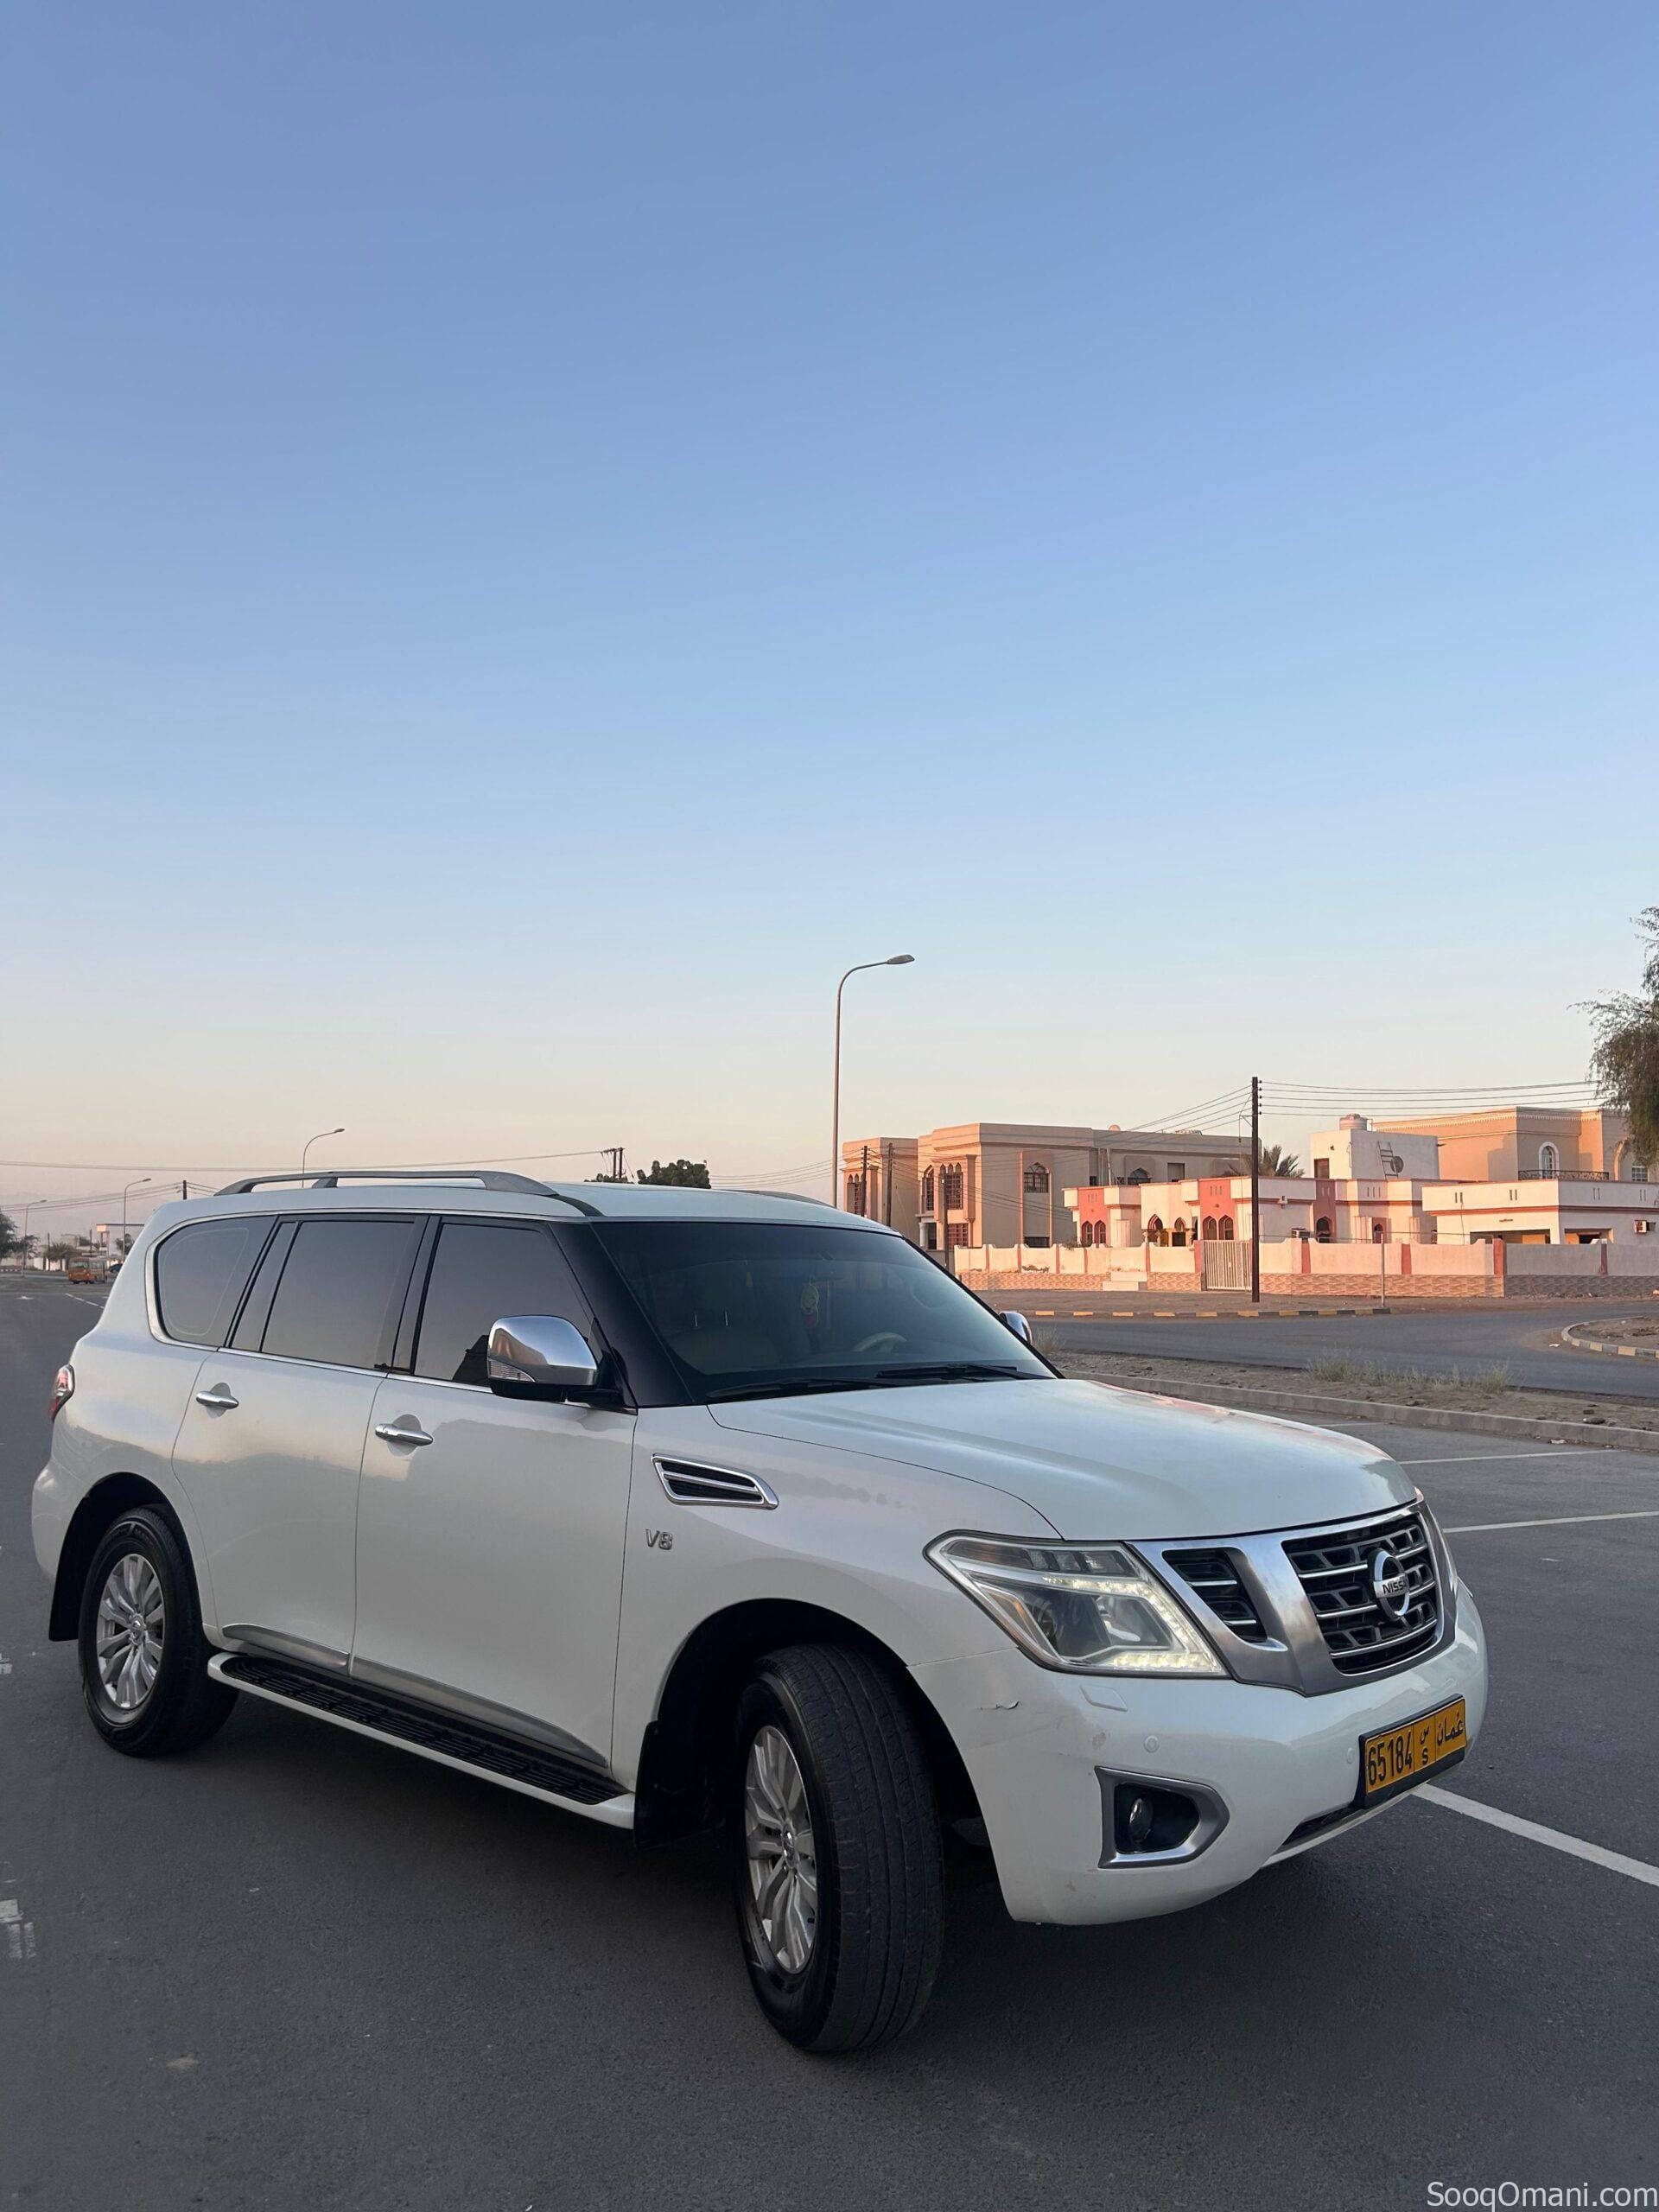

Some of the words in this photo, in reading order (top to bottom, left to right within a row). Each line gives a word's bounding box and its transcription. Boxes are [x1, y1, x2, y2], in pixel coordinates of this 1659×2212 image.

[645, 1529, 673, 1550] V8
[1382, 1580, 1406, 1594] NISS
[1368, 1730, 1412, 1786] 65184
[1421, 1747, 1428, 1765] S
